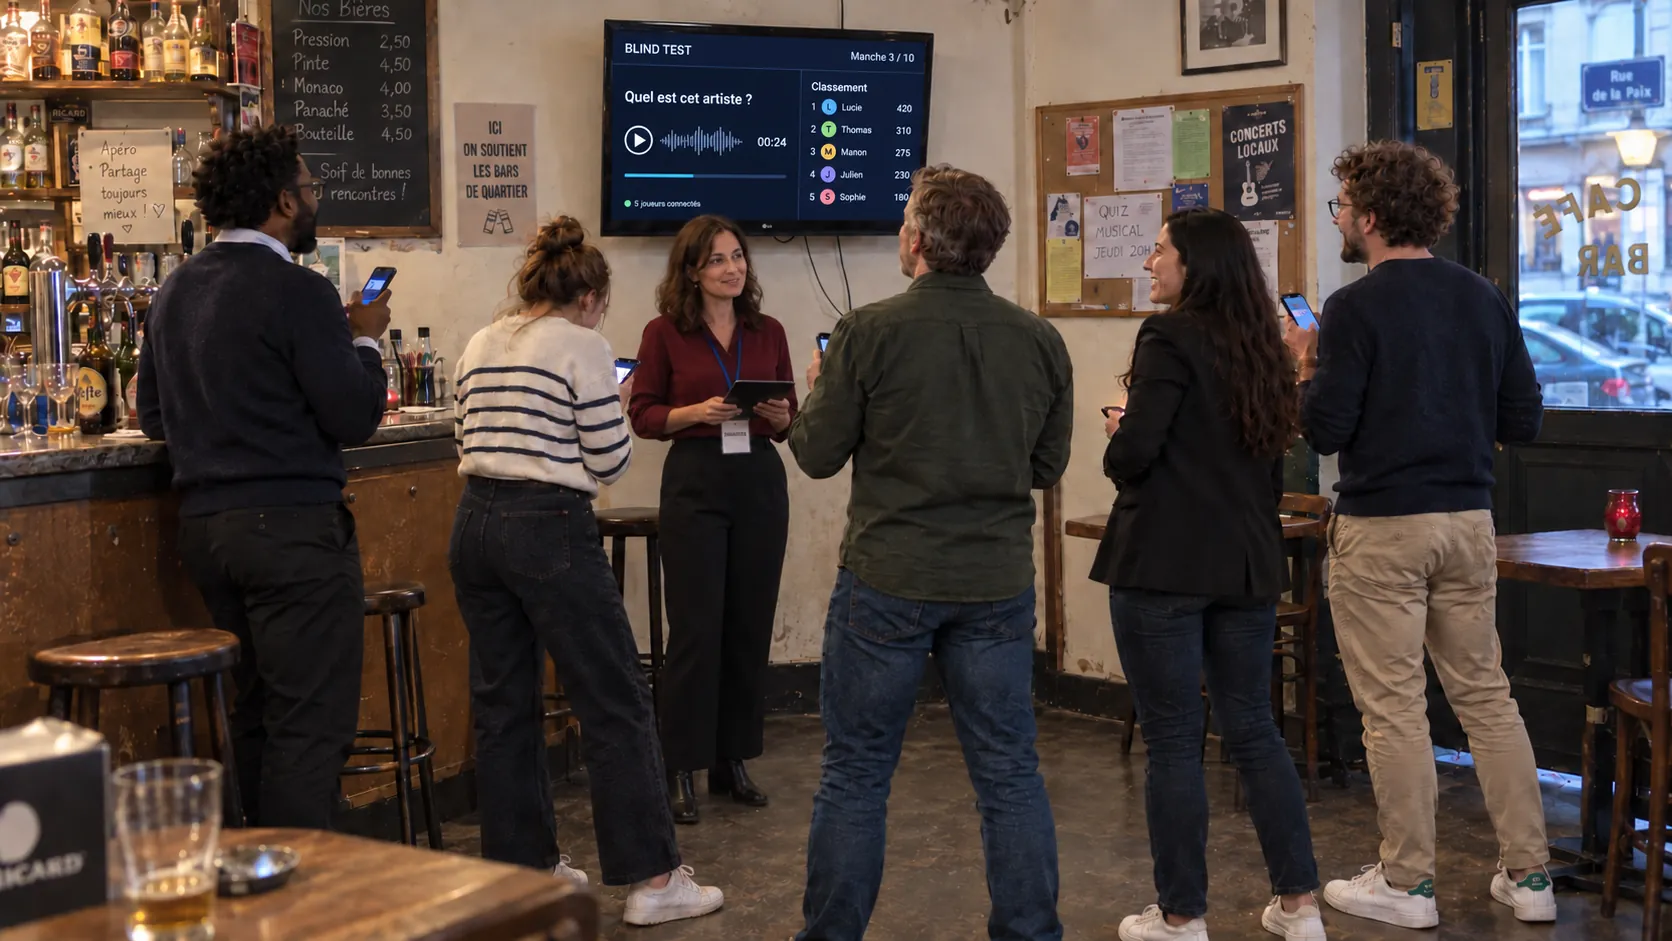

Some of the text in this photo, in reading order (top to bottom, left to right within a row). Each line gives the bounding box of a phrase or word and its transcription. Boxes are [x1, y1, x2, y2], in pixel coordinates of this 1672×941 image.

[298, 0, 330, 16] Nos
[292, 28, 411, 51] Pression 2,50
[624, 43, 692, 55] BLIND TEST
[292, 52, 411, 74] Pinte 4,50
[850, 51, 915, 63] Manche 3 / 10
[1610, 70, 1634, 83] Rue
[294, 77, 412, 97] Monaco 4,00
[811, 81, 868, 93] Classement
[1592, 84, 1652, 102] de la Paix
[624, 90, 753, 105] Quel est cet artiste ?
[294, 100, 412, 120] Panaché 3,50
[811, 102, 816, 111] 1
[841, 103, 863, 112] Lucie
[896, 104, 913, 113] 420
[294, 123, 413, 143] Bouteille 4,50
[488, 120, 502, 135] ICI
[810, 125, 912, 135] 2 T Thomas 310
[1230, 119, 1287, 144] CONCERTS
[463, 143, 527, 157] ON SOUTIENT
[757, 137, 787, 148] 00:24
[1237, 138, 1279, 159] LOCAUX
[101, 140, 137, 162] Apéro
[810, 147, 816, 156] 3
[841, 148, 867, 156] Manon
[895, 148, 911, 157] 275
[100, 162, 148, 184] Partage
[320, 162, 411, 182] Soif de bonnes
[473, 163, 519, 178] LES BARS
[809, 170, 910, 179] 4 J Julien 230
[101, 186, 148, 204] toujours
[331, 182, 407, 201] rencontres !
[465, 184, 528, 200] DE QUARTIER
[809, 193, 816, 201] 5
[840, 193, 866, 203] Sophie
[894, 193, 909, 201] 180
[103, 203, 147, 220] mieux !
[634, 200, 701, 209] 5 joueurs connectés
[1098, 204, 1129, 220] QUIZ
[1095, 224, 1143, 239] MUSICAL
[1094, 244, 1151, 259] JEUDI 20H
